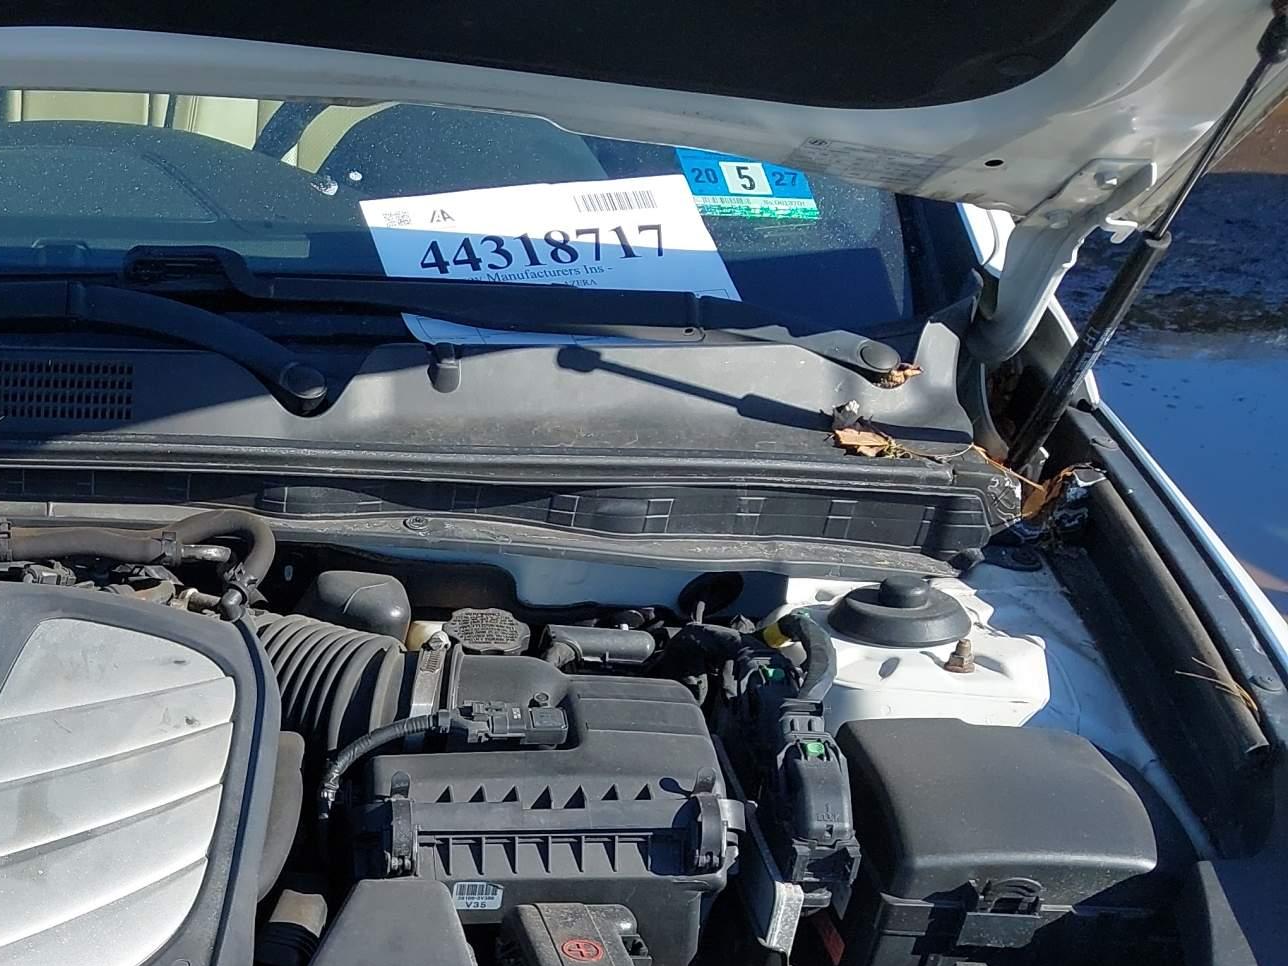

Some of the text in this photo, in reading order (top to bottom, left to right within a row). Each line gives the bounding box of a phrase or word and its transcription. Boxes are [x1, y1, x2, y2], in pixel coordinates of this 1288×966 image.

[691, 165, 798, 190] 20 5 27
[420, 223, 663, 275] 44318717
[486, 266, 581, 284] Manufacturers
[583, 264, 605, 275] Ins
[465, 901, 487, 909] V35
